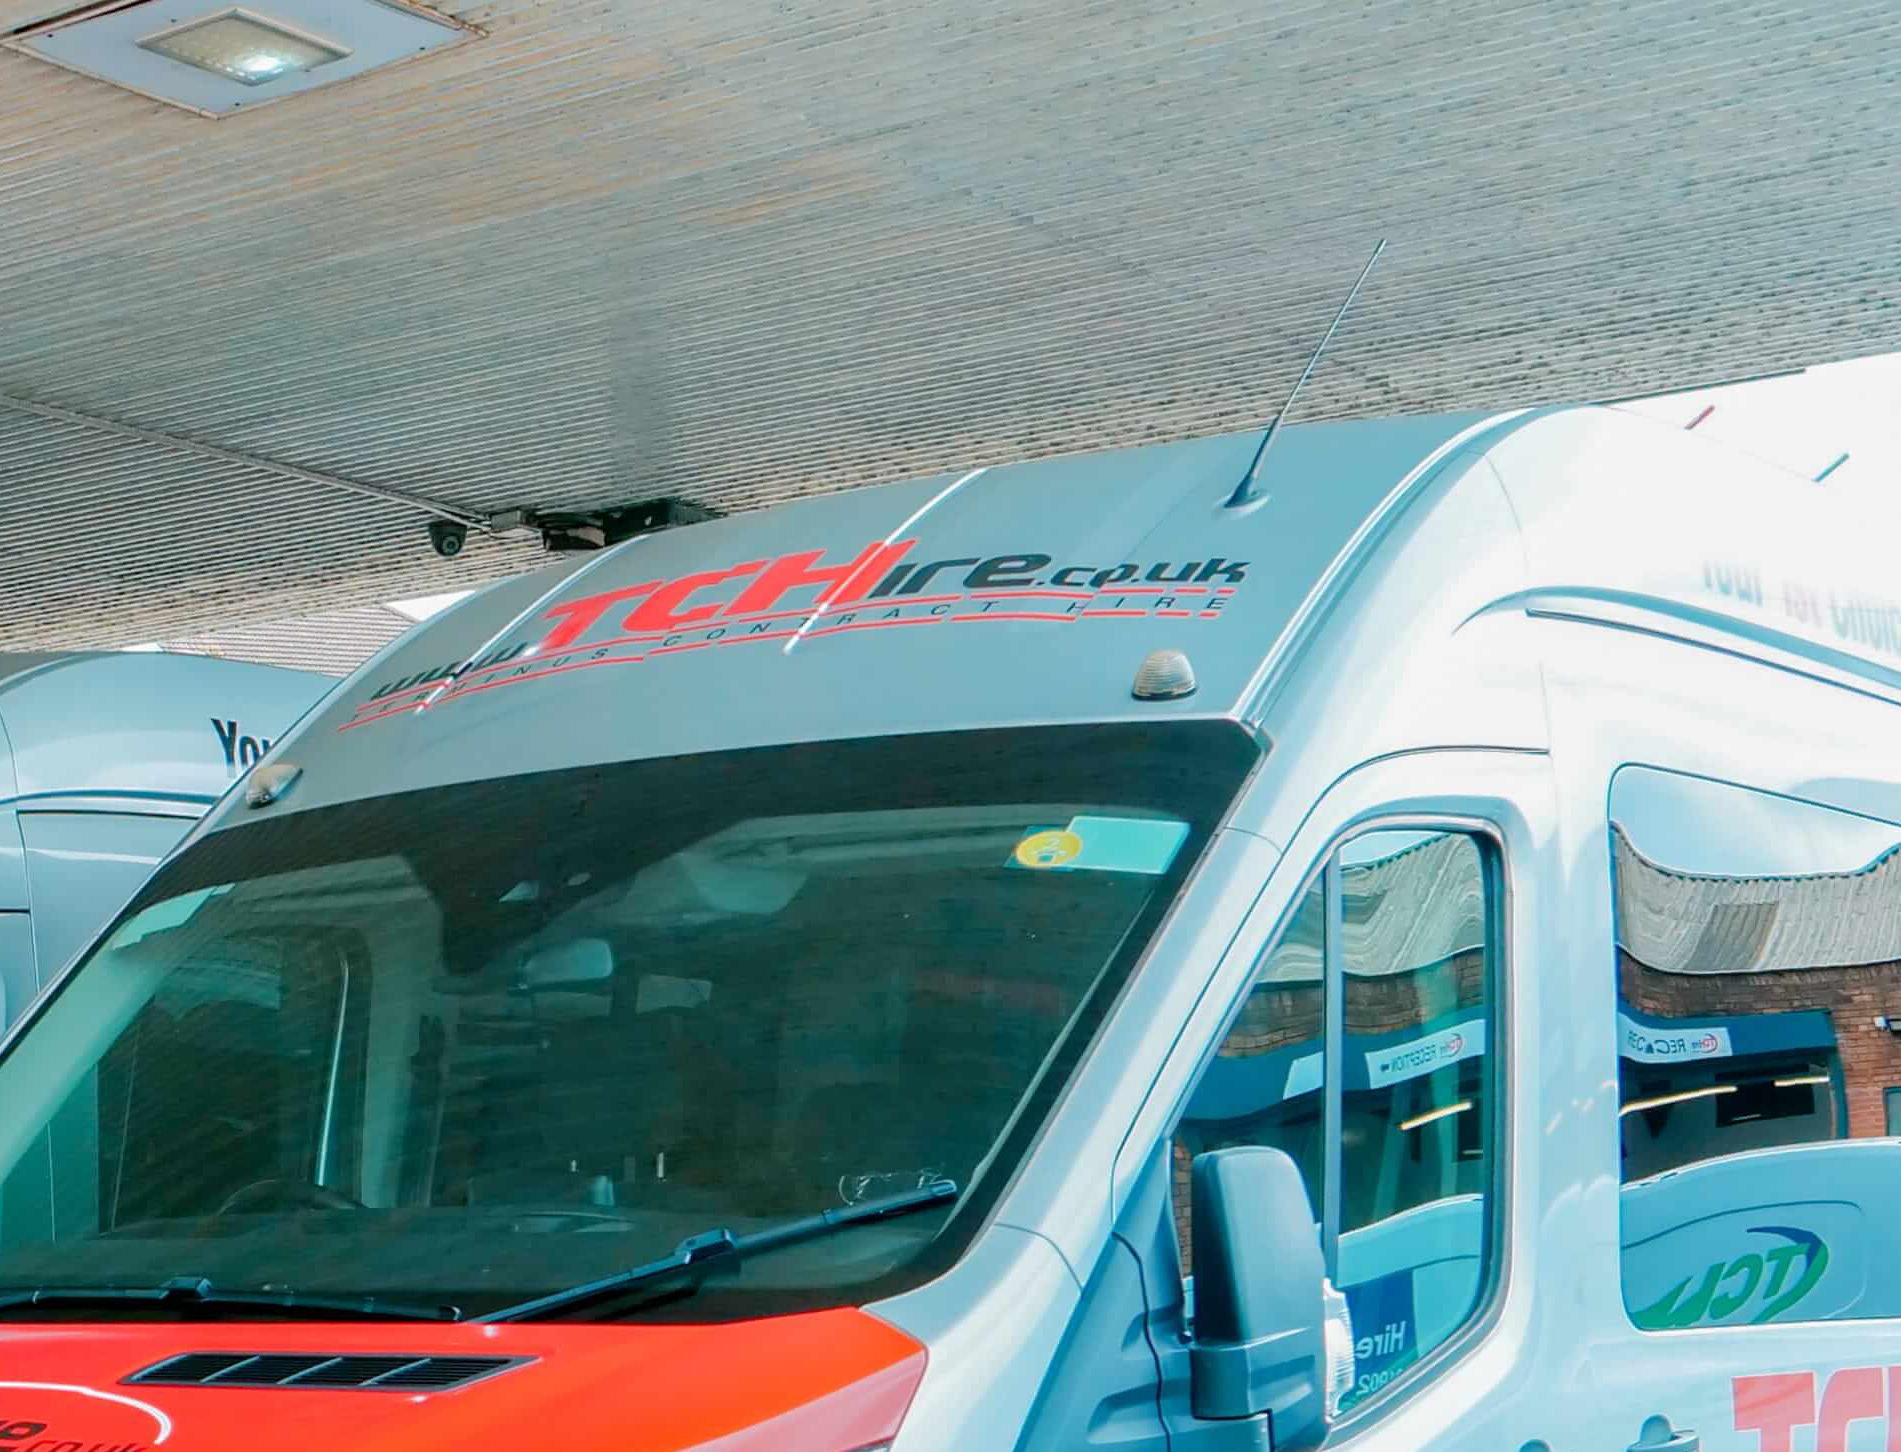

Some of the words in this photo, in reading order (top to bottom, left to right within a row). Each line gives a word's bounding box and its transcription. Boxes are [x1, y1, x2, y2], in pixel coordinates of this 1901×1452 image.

[661, 600, 1001, 648] CONTRACT
[1064, 596, 1229, 615] HIRE
[210, 716, 273, 778] Yo
